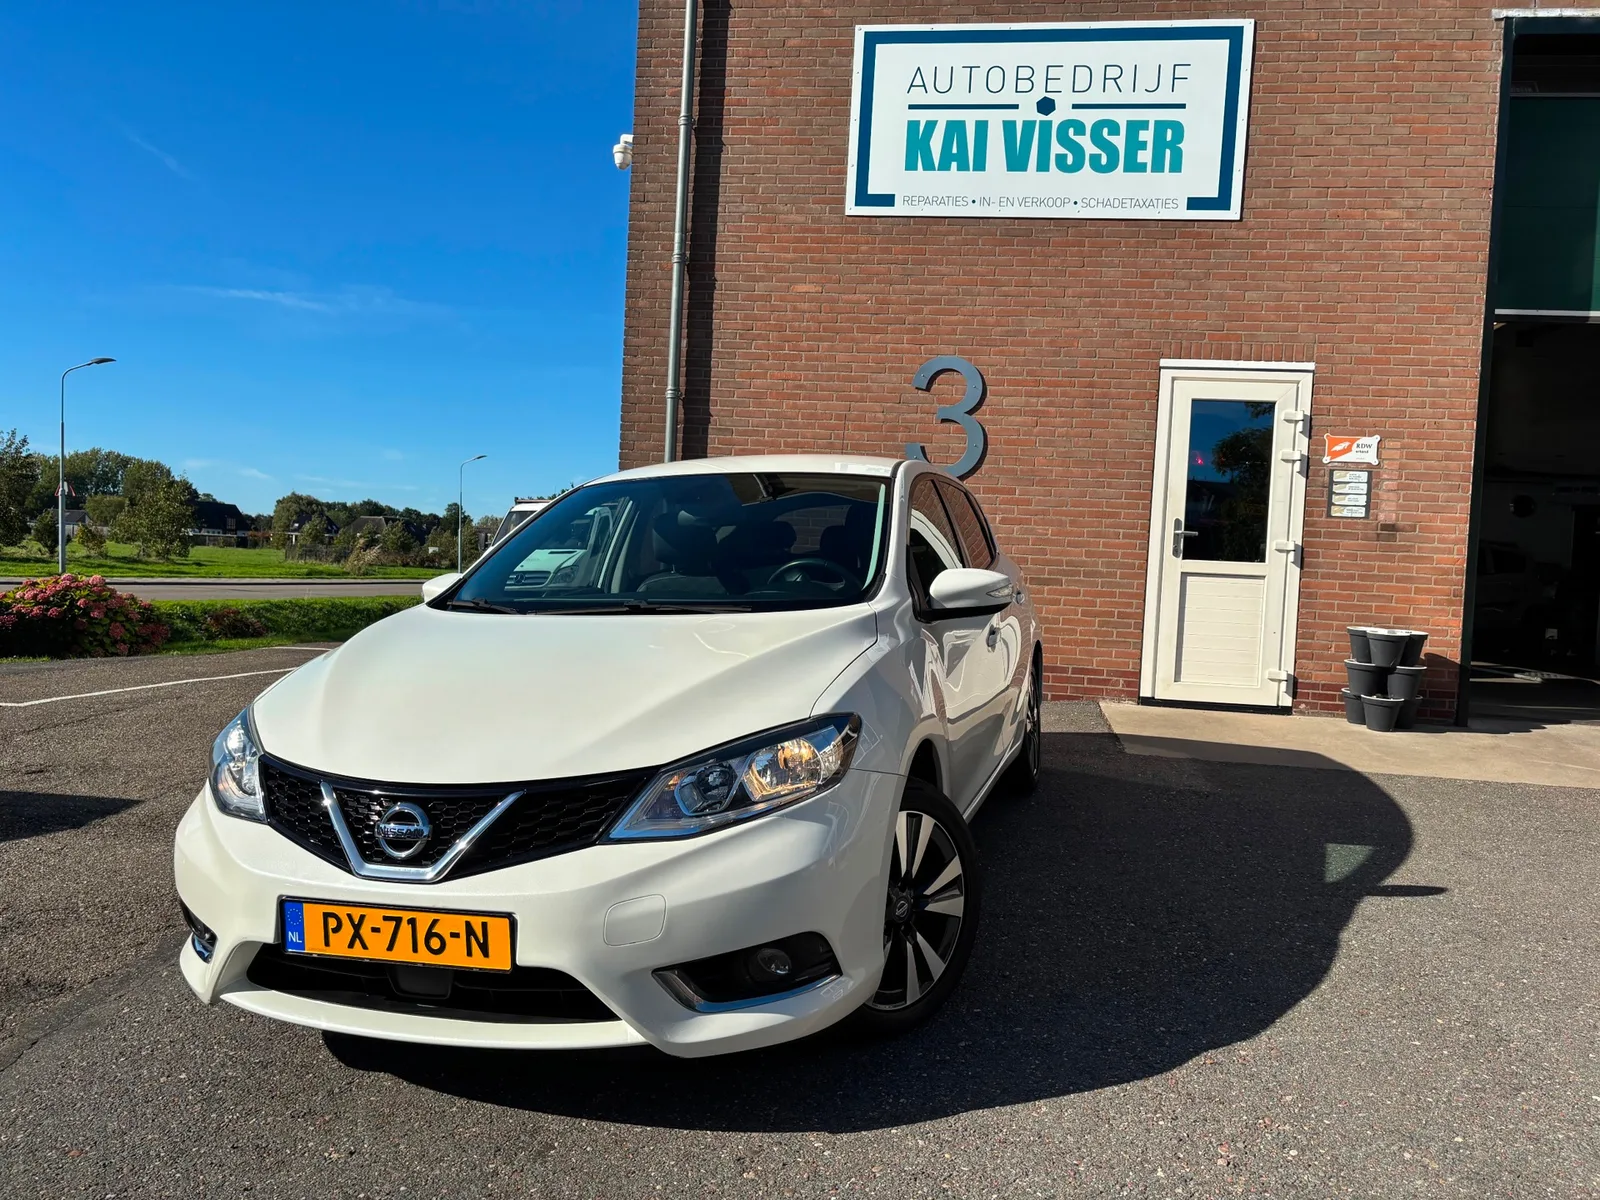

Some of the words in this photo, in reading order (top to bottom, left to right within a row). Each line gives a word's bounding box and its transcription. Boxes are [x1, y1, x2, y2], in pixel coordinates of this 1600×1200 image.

[906, 63, 1192, 94] AUTOBEDRIJF
[904, 119, 989, 172] KAI
[1002, 118, 1185, 174] VISSER
[902, 195, 969, 207] REPARATIES
[979, 196, 996, 207] IN-
[998, 196, 1015, 207] EN
[1016, 196, 1071, 208] VERKOOP
[1080, 197, 1179, 210] SCHADETAXATIES
[904, 355, 984, 479] 3
[377, 825, 425, 838] NISSAN
[288, 931, 303, 943] NL
[322, 911, 490, 959] PX-716-N
